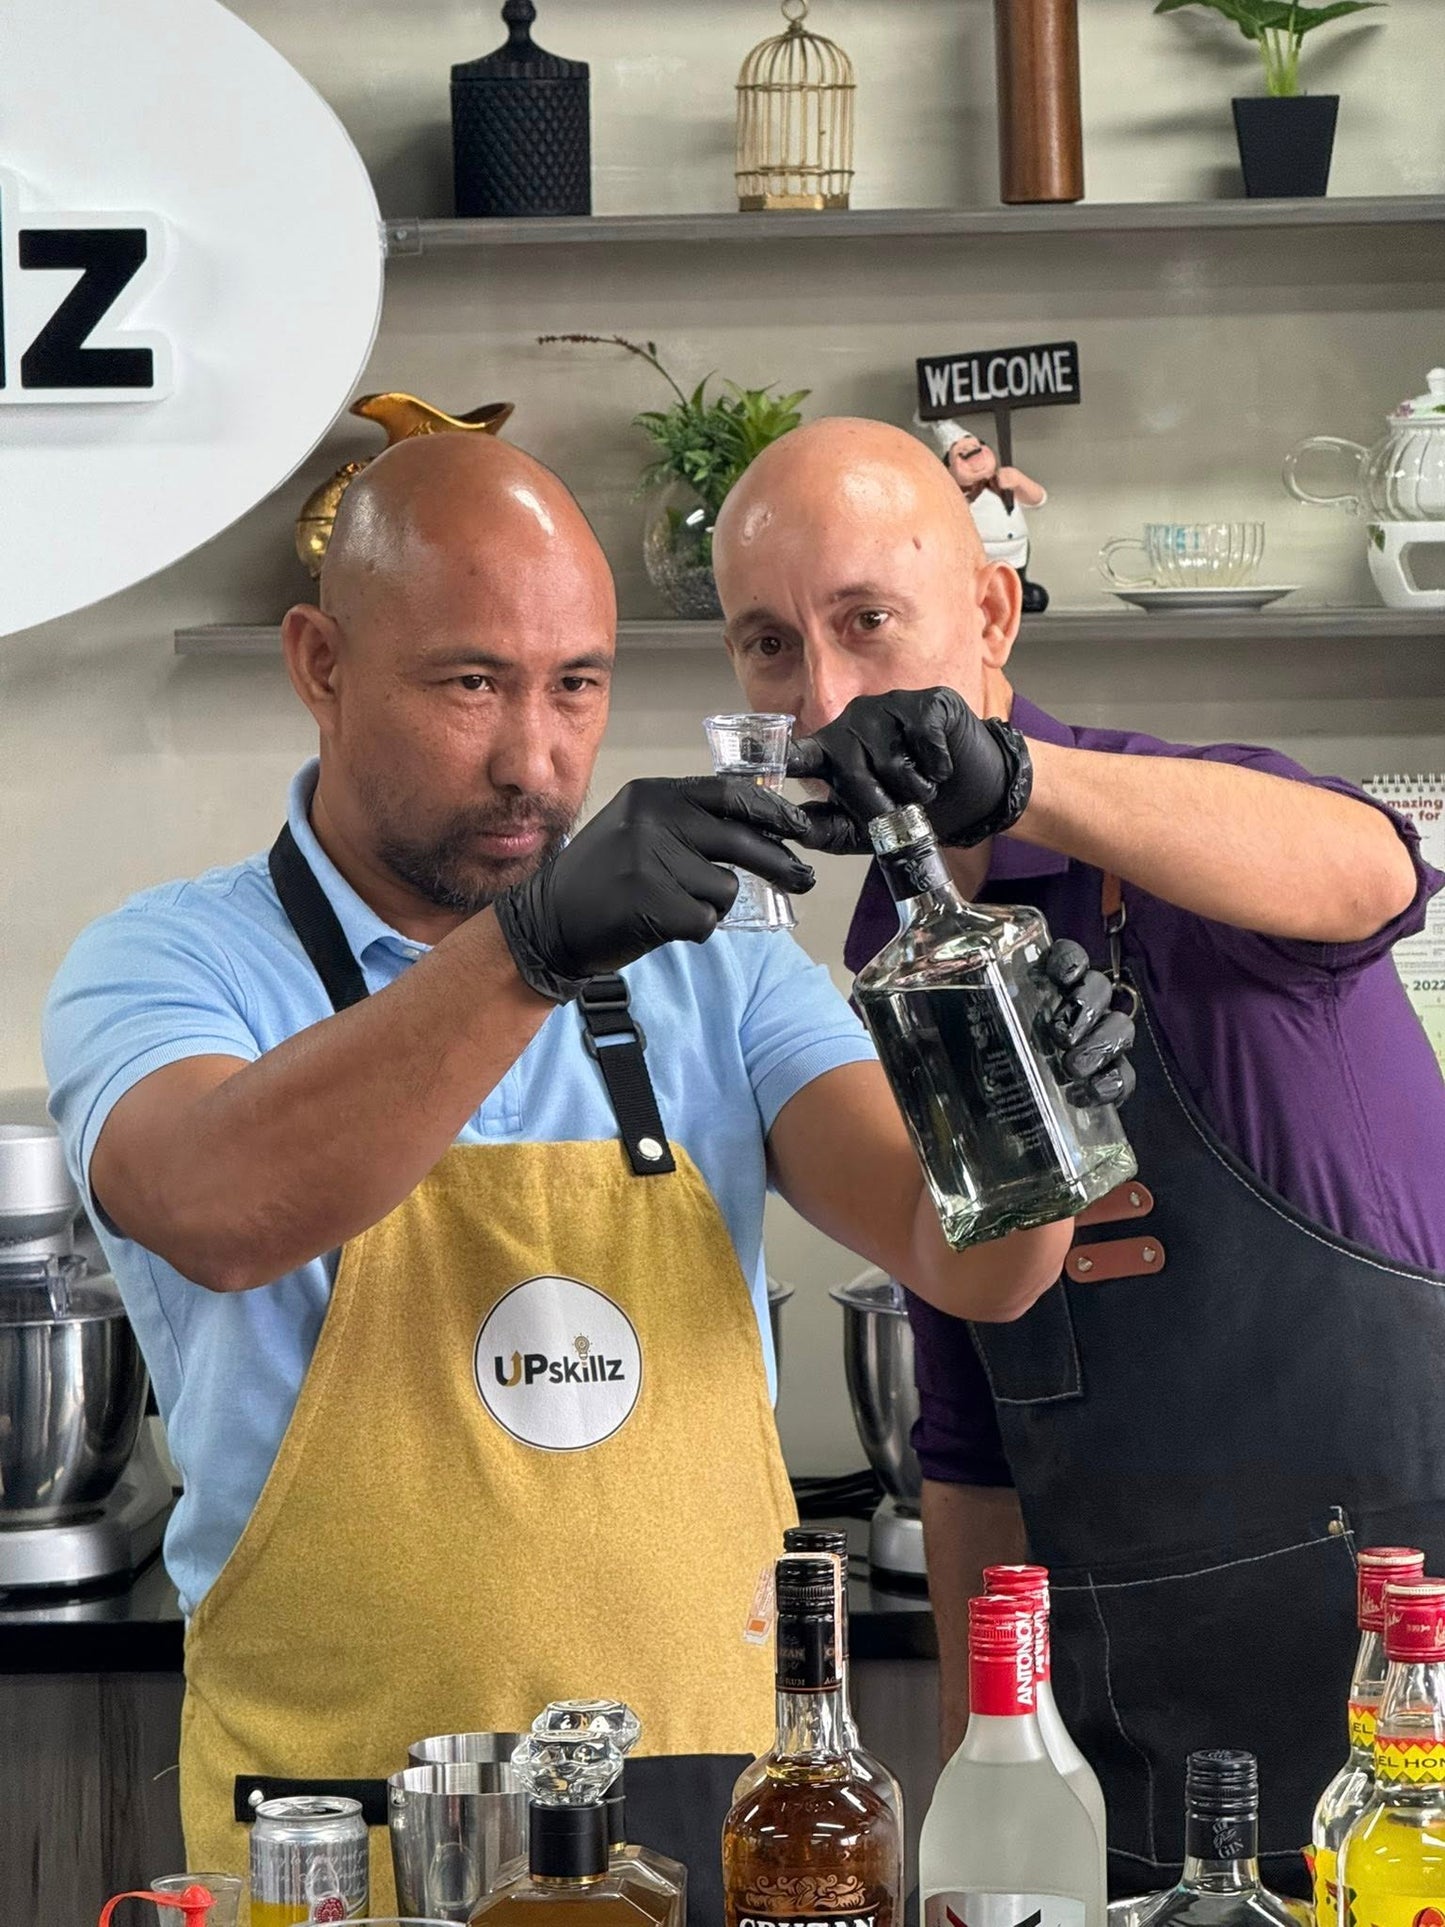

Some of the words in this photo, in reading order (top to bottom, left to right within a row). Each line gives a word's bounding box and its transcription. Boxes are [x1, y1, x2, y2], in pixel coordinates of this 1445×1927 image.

[0, 187, 154, 390] z
[924, 350, 1073, 408] WELCOME
[1386, 796, 1443, 810] mazing
[1419, 810, 1440, 821] for
[1413, 980, 1445, 991] 2022
[494, 1350, 626, 1388] UPskillz
[1015, 1610, 1034, 1706] ANTONOV
[1353, 1722, 1374, 1735] EL
[1378, 1755, 1400, 1768] EL
